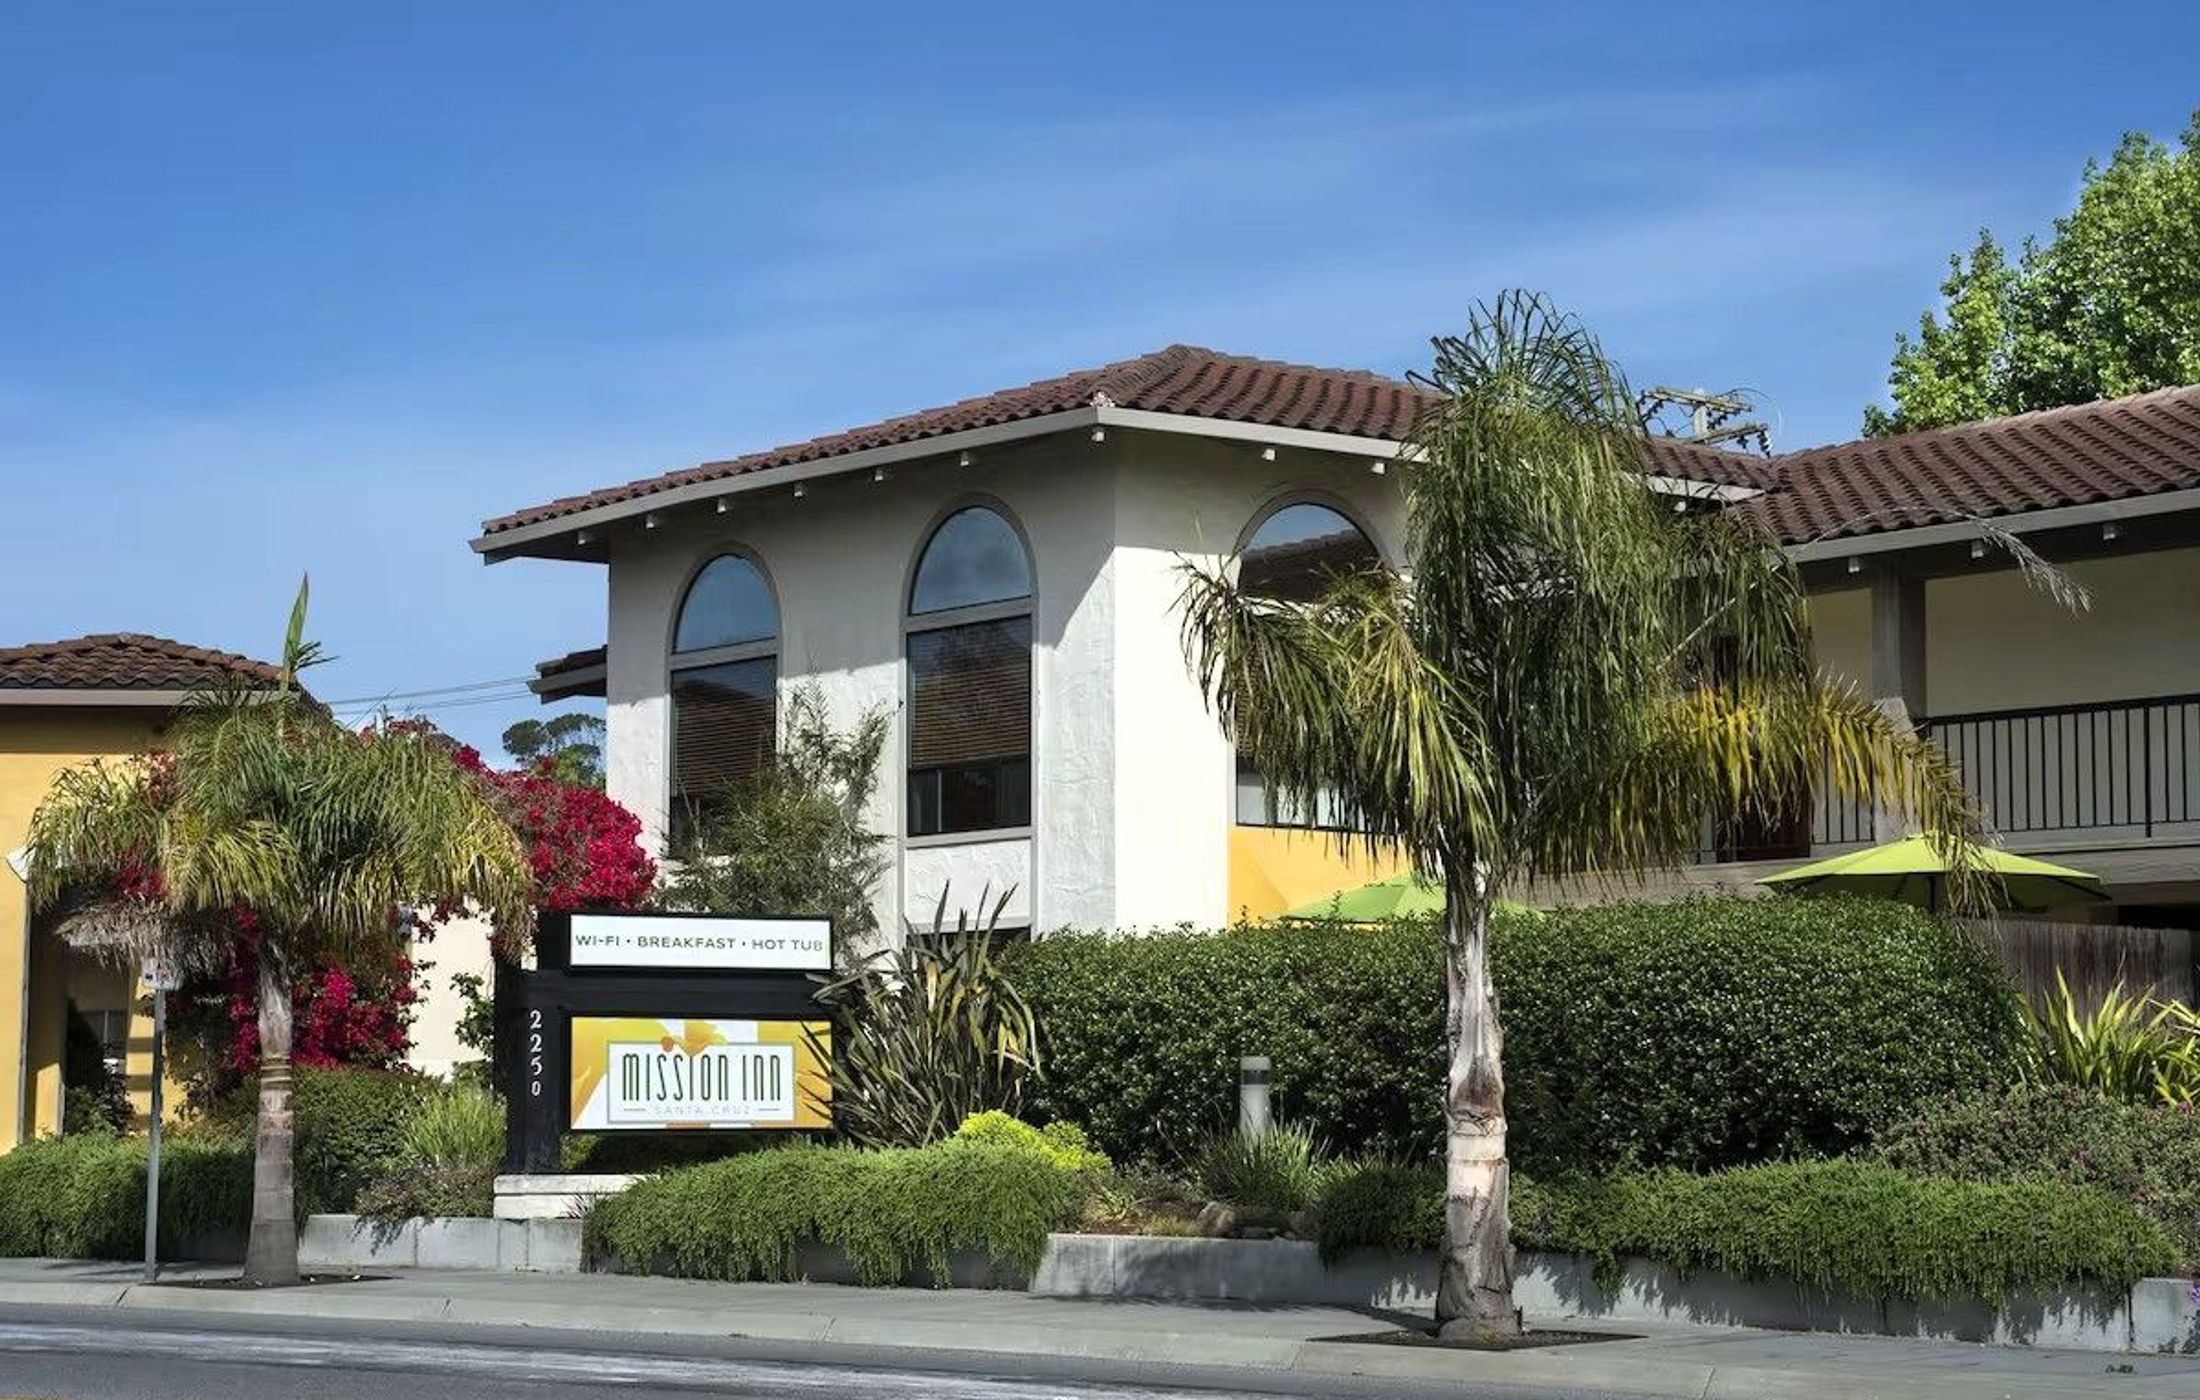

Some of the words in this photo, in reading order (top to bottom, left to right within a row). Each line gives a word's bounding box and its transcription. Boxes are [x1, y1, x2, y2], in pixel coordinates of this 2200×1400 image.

[575, 934, 620, 947] WI-FI
[637, 935, 737, 950] BREAKFAST
[751, 938, 787, 950] HOT
[791, 939, 823, 952] TUB
[529, 1009, 543, 1097] 2250
[622, 1053, 729, 1101] MISSION
[742, 1054, 781, 1101] INN
[655, 1105, 702, 1115] SANTA
[710, 1105, 750, 1116] CRUZ
